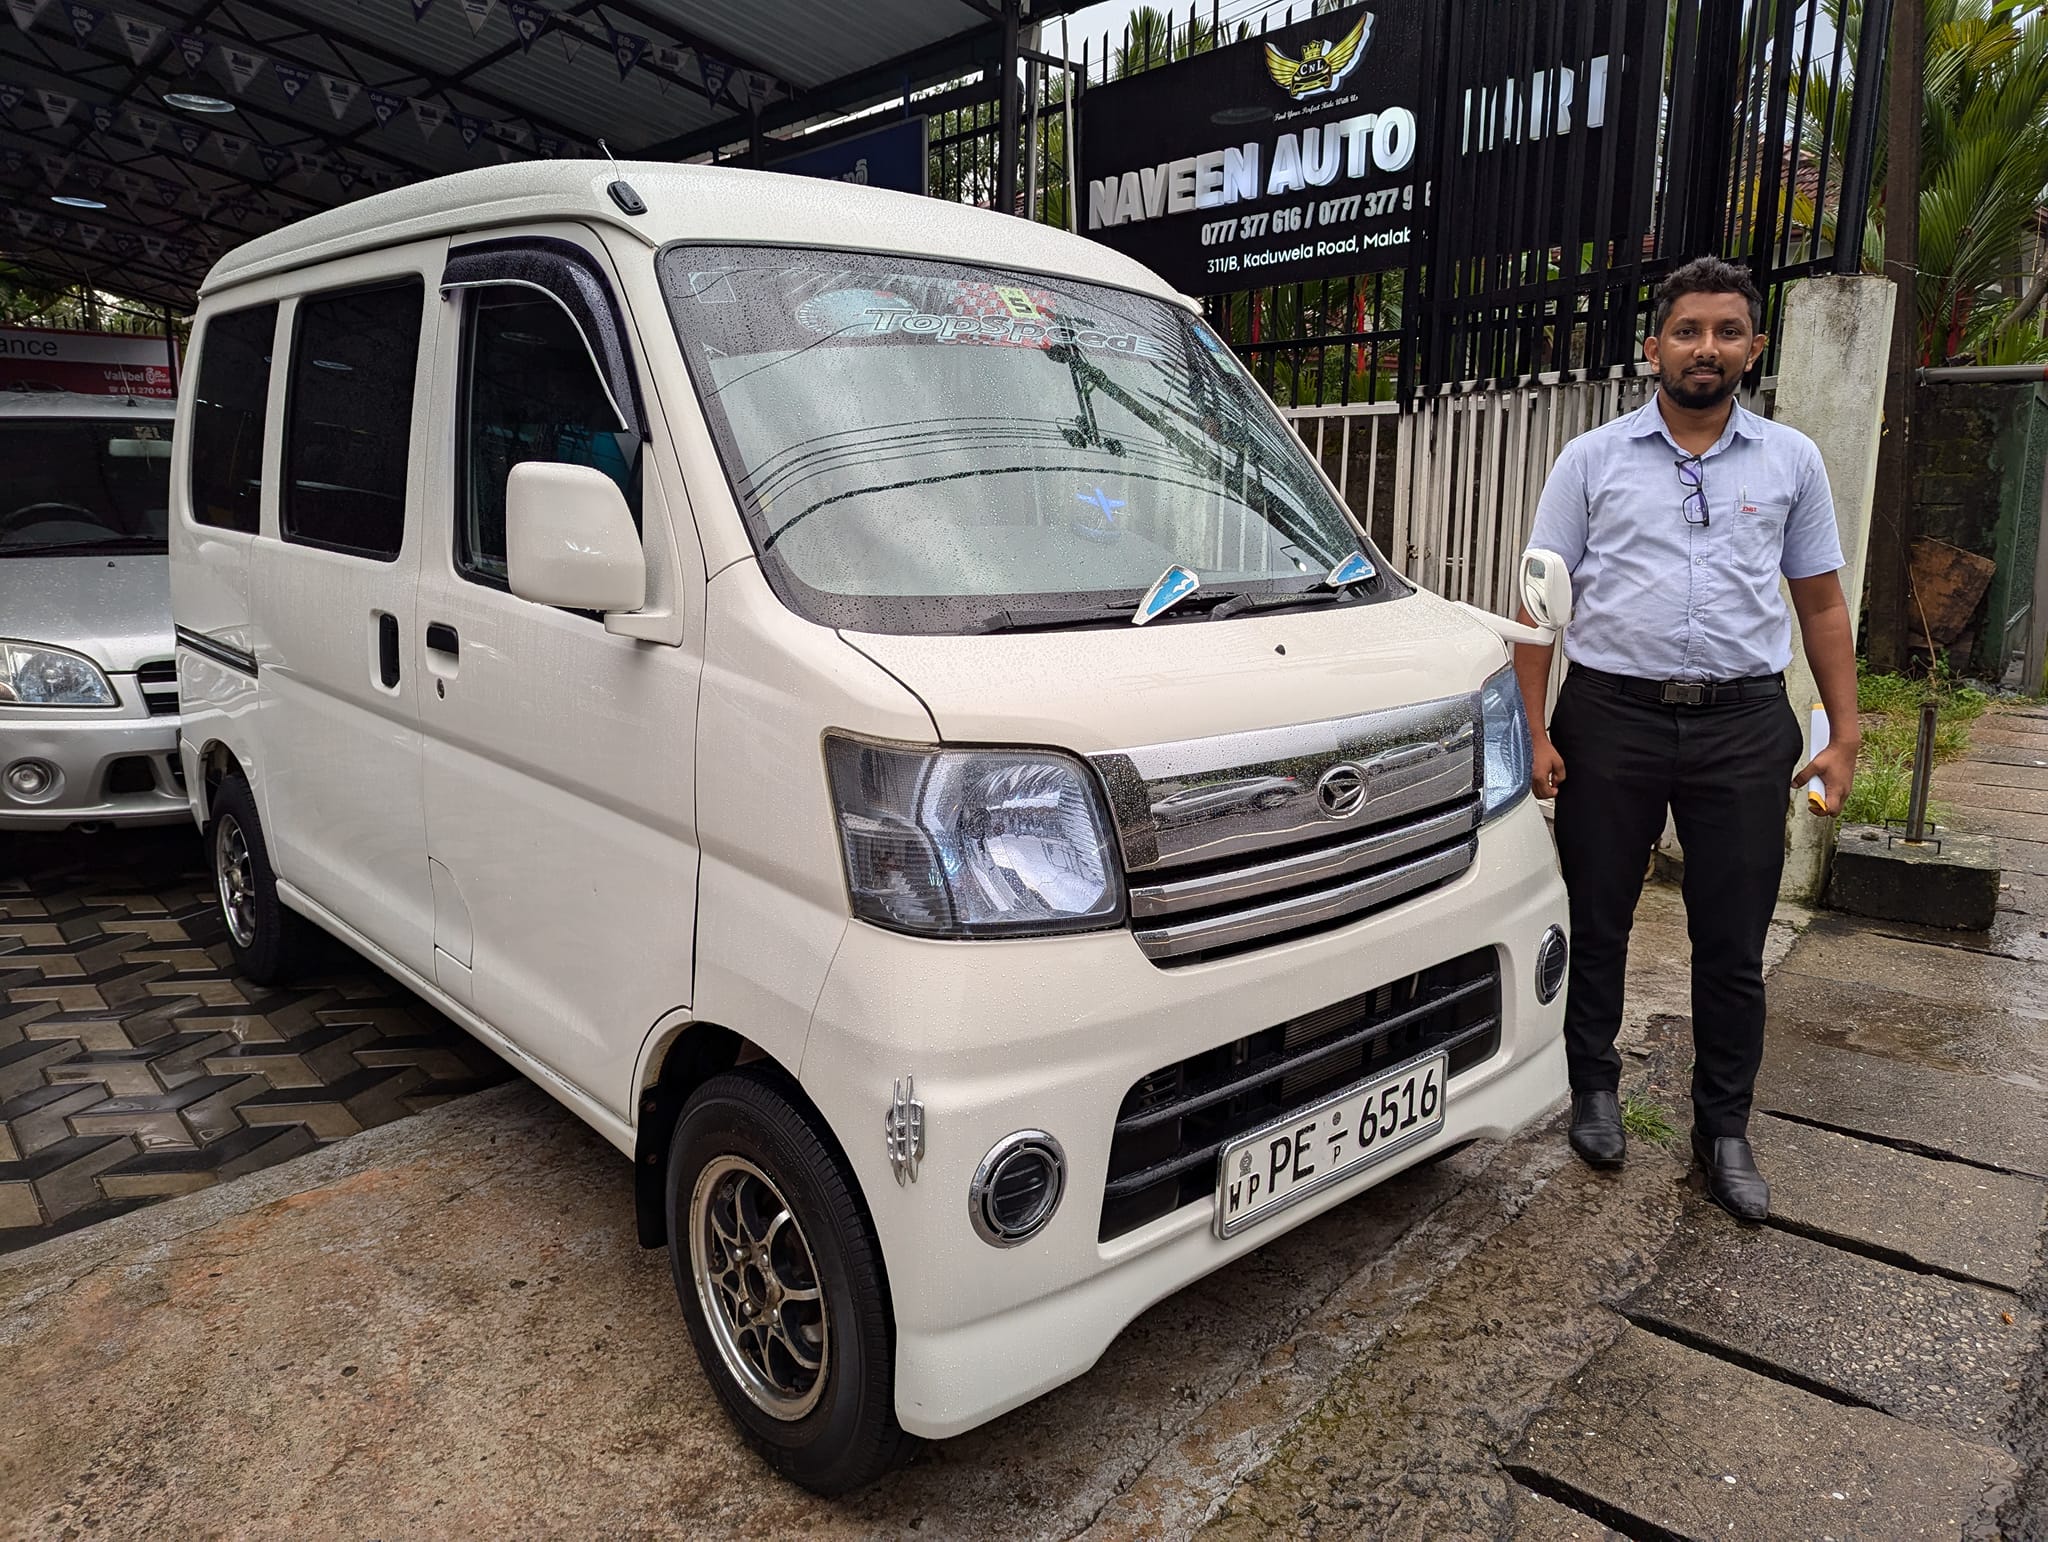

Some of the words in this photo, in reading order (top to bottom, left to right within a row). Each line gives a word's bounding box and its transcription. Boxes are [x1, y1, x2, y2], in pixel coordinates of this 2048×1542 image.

[1300, 60, 1323, 75] CNL
[1088, 142, 1260, 230] NAVEEN
[1267, 106, 1416, 195] AUTO
[1201, 219, 1238, 246] 0777
[1240, 212, 1269, 239] 377
[1272, 206, 1302, 234] 616
[1318, 194, 1362, 226] 0777
[1364, 187, 1399, 217] 377
[1207, 256, 1241, 273] 311/B,
[1243, 243, 1313, 268] Kaduwela
[1317, 235, 1359, 256] Road,
[1268, 1122, 1317, 1194] PE
[1358, 1068, 1438, 1148] 6516
